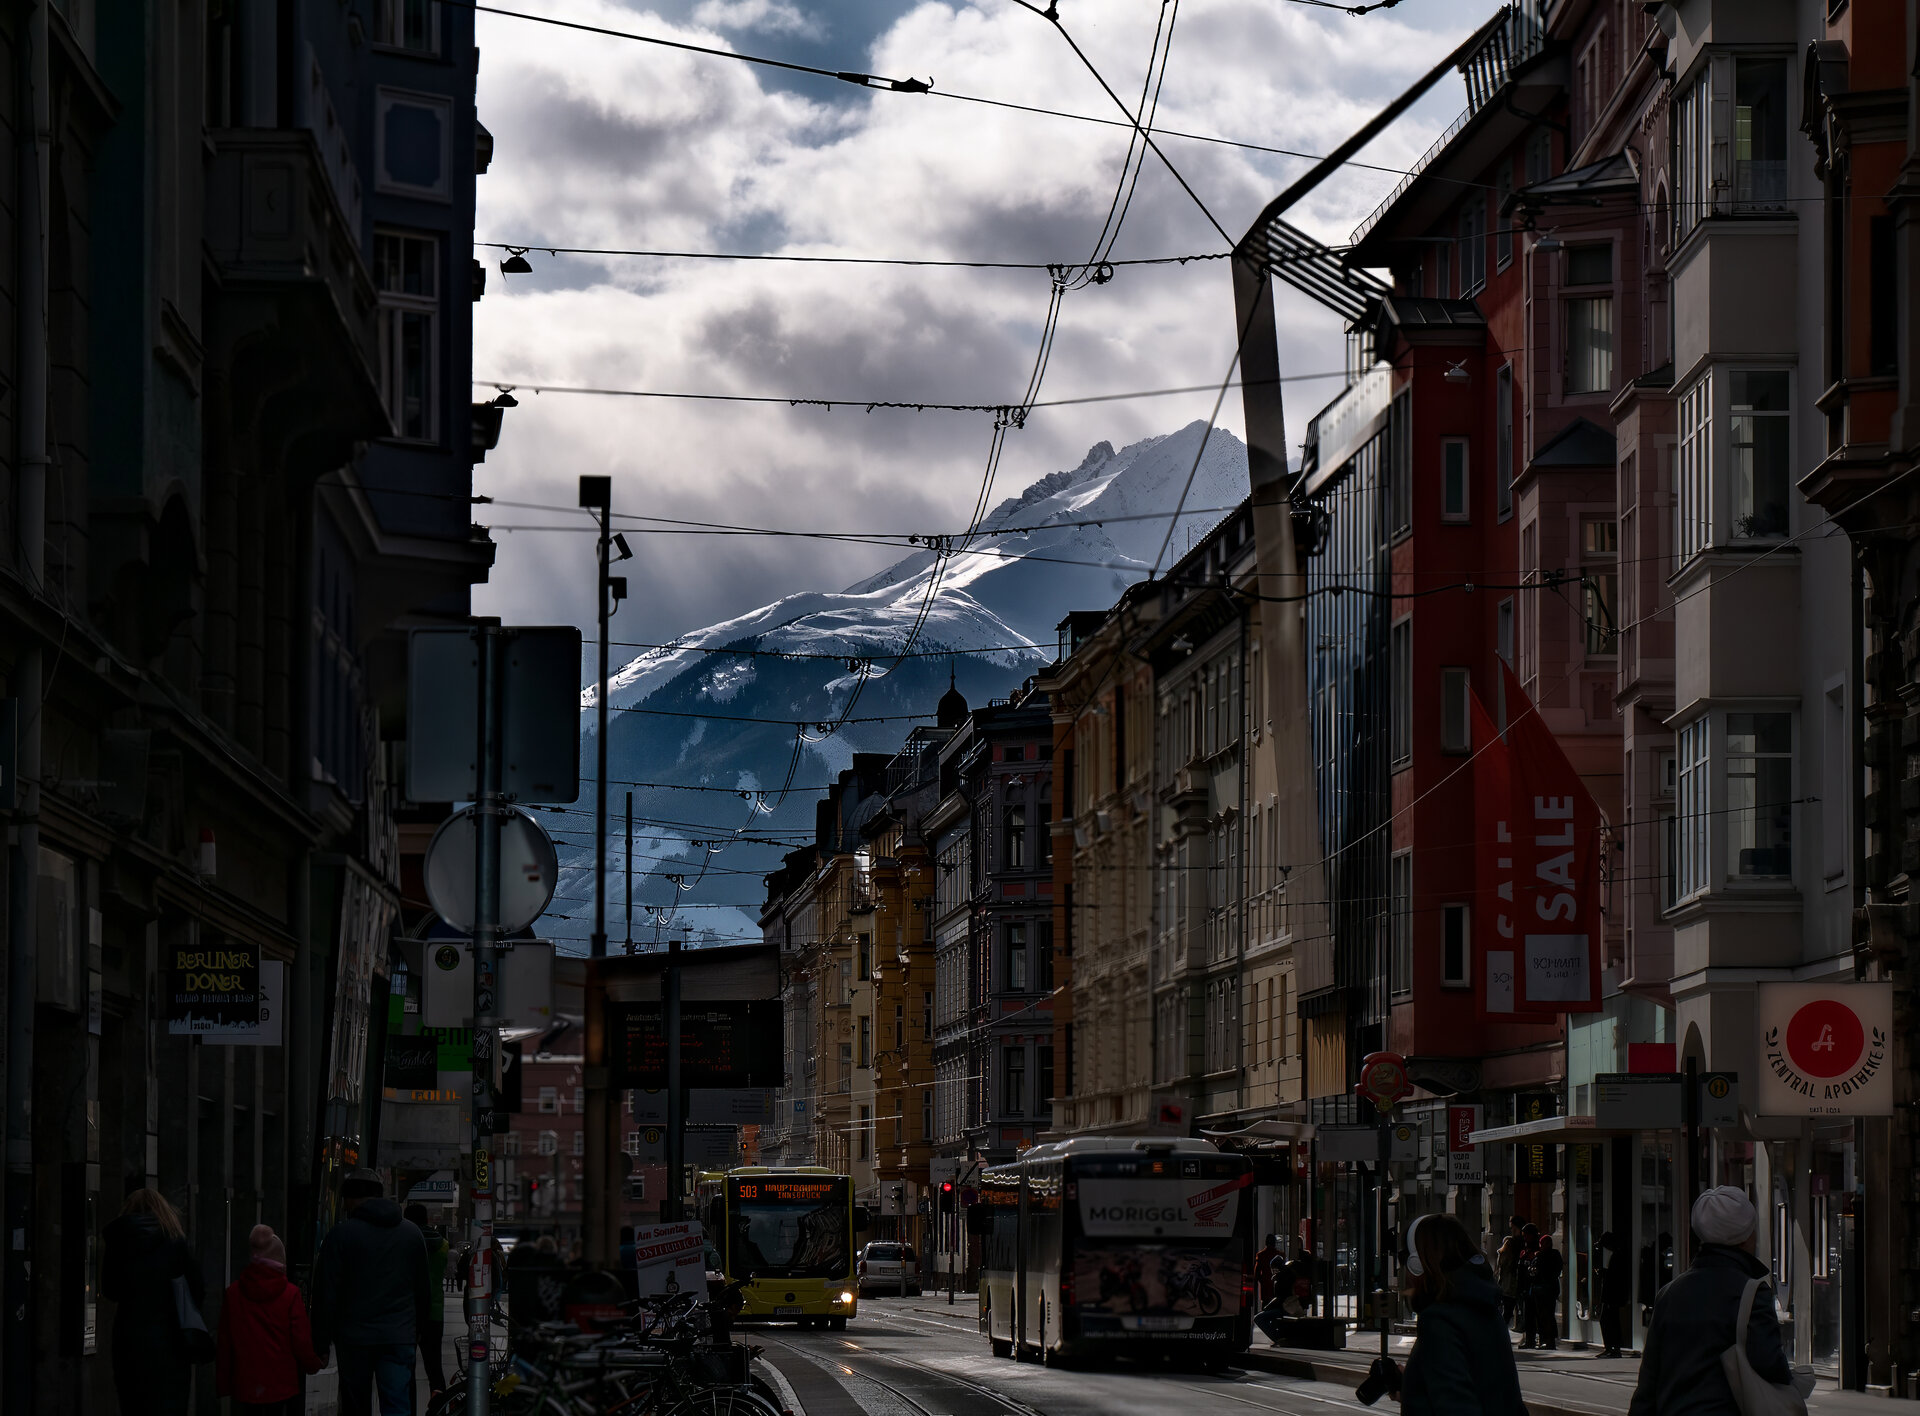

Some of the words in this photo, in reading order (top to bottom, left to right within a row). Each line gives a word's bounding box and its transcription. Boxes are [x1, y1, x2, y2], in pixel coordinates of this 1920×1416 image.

[1534, 796, 1577, 922] SALE
[1767, 1050, 1816, 1099] ZENTRAL
[1824, 1050, 1884, 1100] APOTHEKE
[739, 1185, 758, 1198] 503
[1089, 1206, 1188, 1221] MORIGGL
[637, 1231, 652, 1241] Am
[653, 1224, 689, 1238] Sonntag
